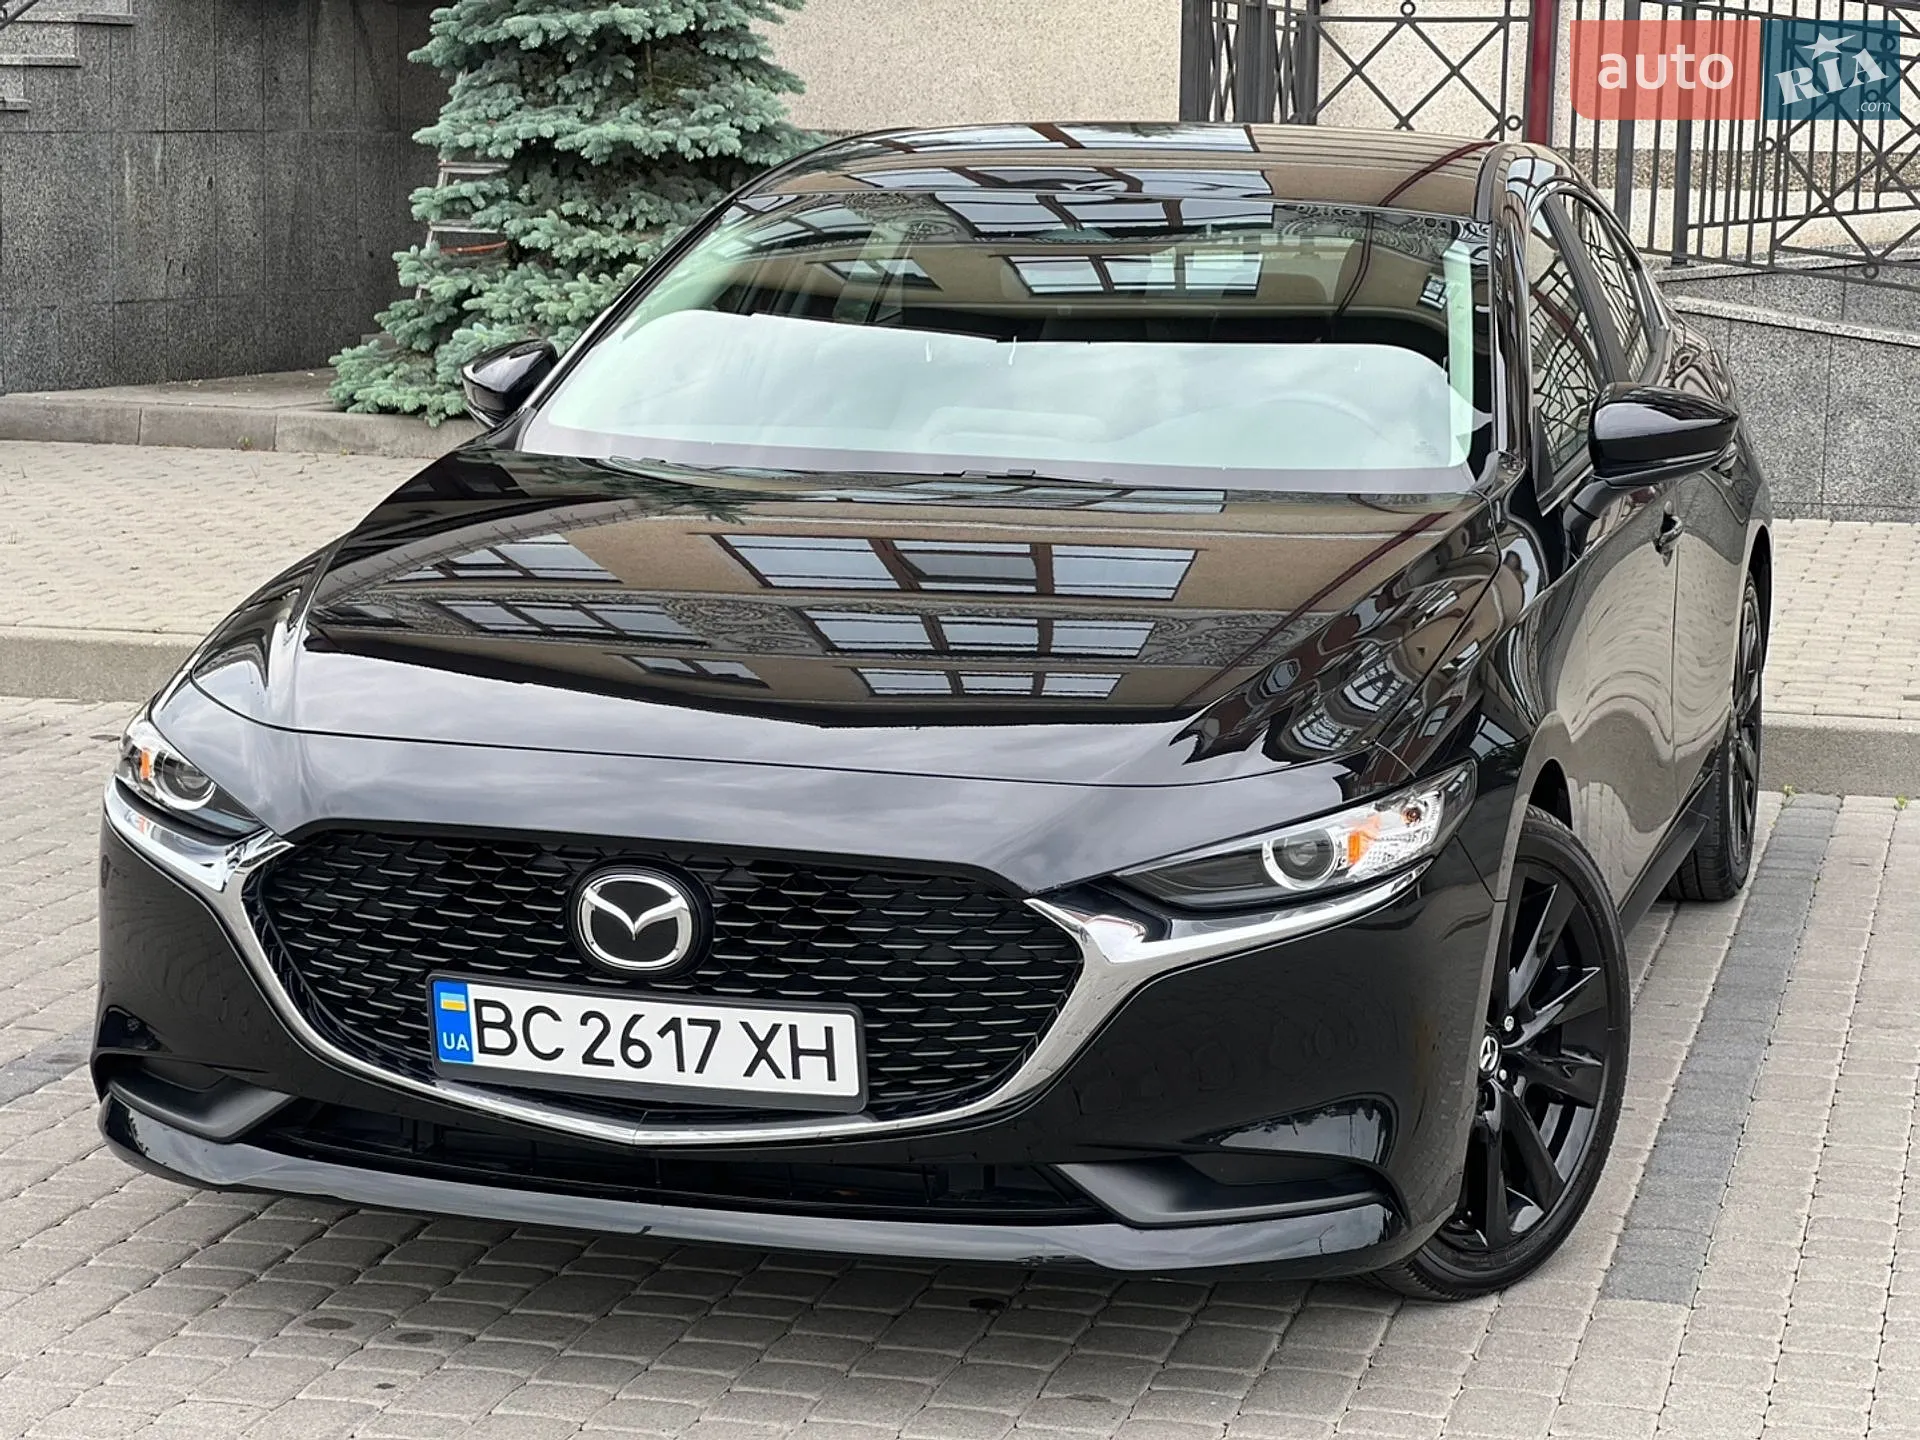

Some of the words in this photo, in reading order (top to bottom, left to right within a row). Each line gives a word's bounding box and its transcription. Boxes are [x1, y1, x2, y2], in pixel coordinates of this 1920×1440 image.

[443, 1031, 470, 1053] UA
[473, 998, 564, 1061] BC
[579, 1010, 722, 1075] 2617
[739, 1020, 837, 1082] XH
